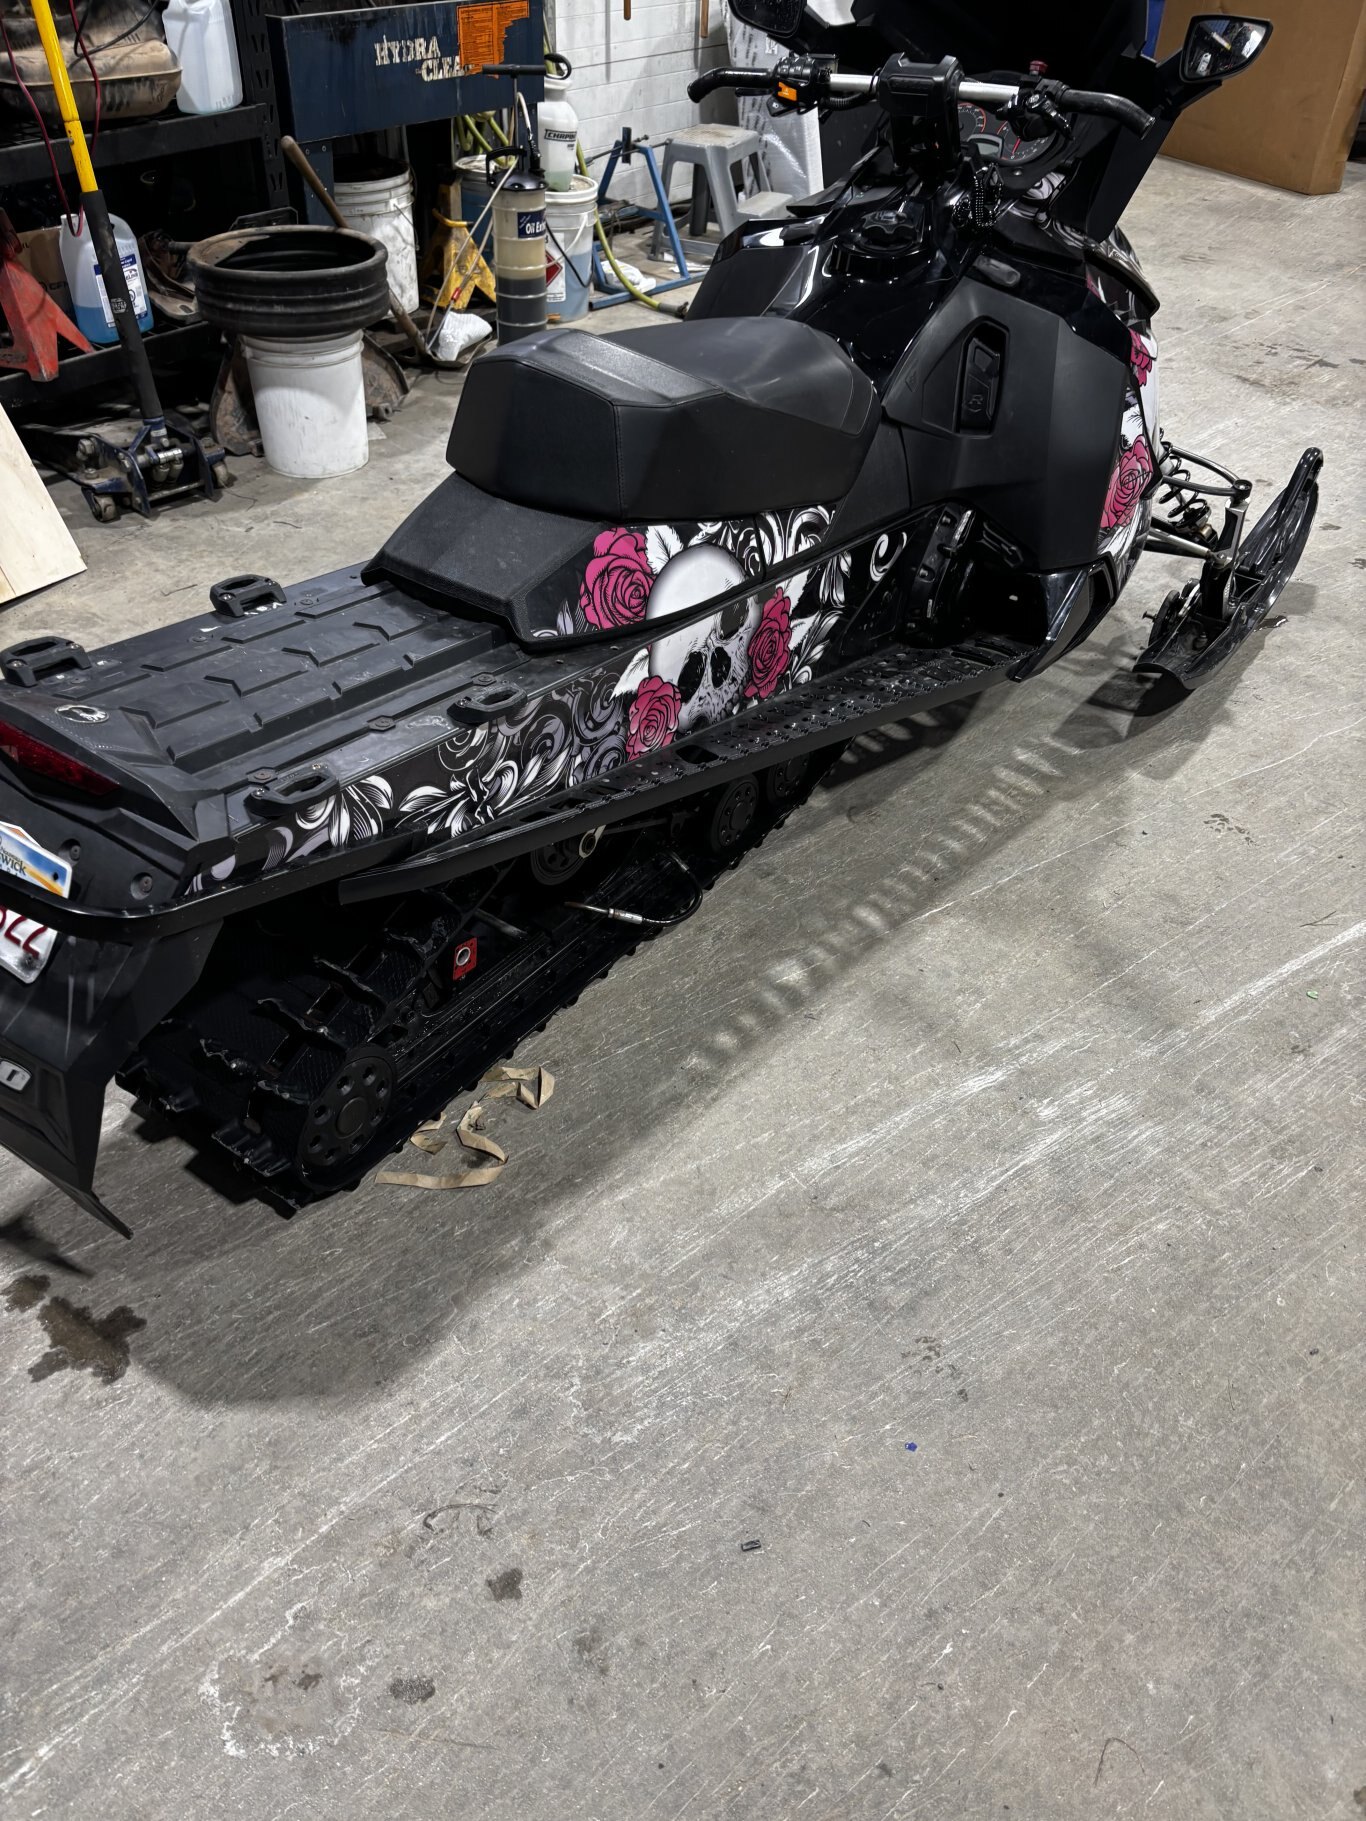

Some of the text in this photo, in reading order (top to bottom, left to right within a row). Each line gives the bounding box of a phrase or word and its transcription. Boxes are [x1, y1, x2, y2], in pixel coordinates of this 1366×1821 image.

[374, 35, 441, 66] HYDRA
[421, 55, 475, 82] CLEA
[0, 853, 27, 877] wick
[0, 906, 48, 961] 22
